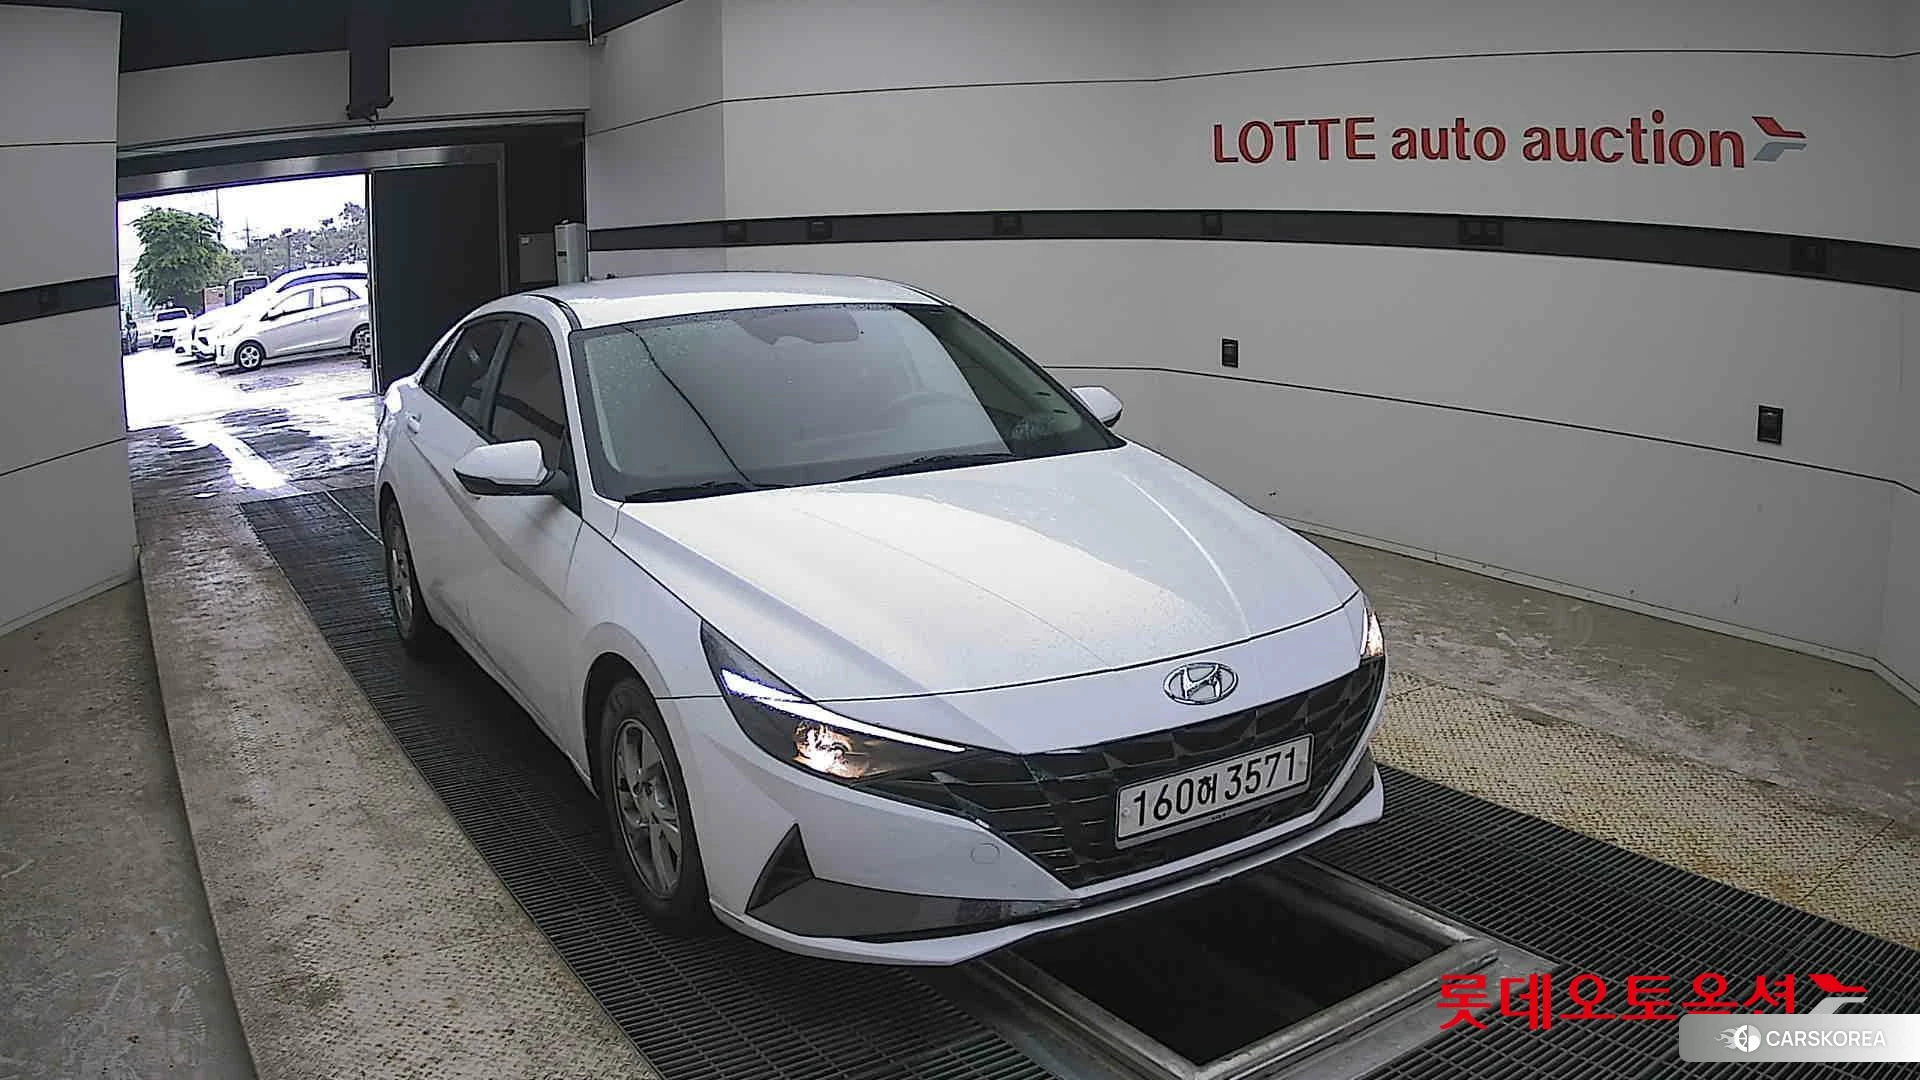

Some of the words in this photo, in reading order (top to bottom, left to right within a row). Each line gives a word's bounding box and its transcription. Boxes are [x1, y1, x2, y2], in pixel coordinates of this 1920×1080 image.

[1213, 116, 1376, 164] LOTTE
[1391, 117, 1506, 161] auto
[1523, 109, 1745, 168] auction
[1225, 747, 1296, 801] 3571
